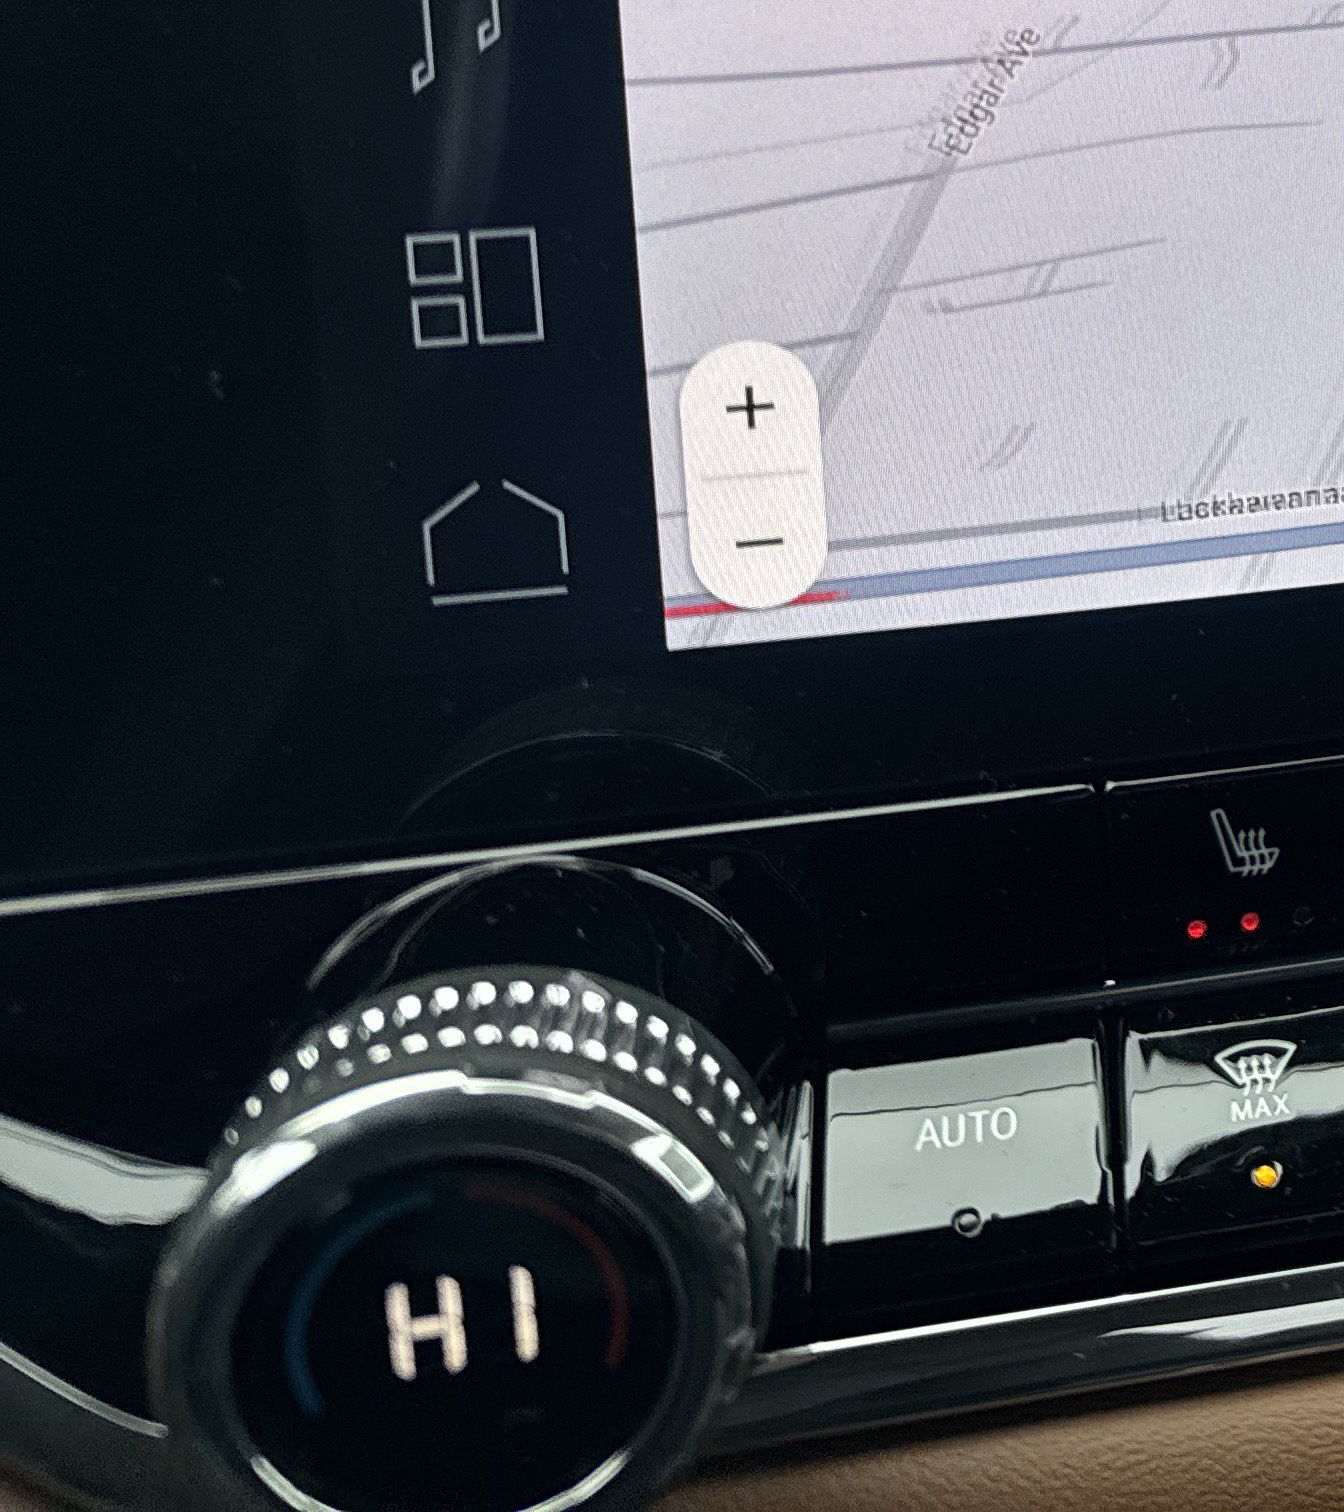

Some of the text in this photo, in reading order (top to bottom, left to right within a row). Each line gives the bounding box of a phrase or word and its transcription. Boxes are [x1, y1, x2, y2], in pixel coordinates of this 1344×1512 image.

[944, 27, 1041, 155] Edgar Ave
[914, 1106, 1019, 1153] AUTO
[1229, 1091, 1291, 1124] MAX
[383, 1263, 541, 1382] HI
